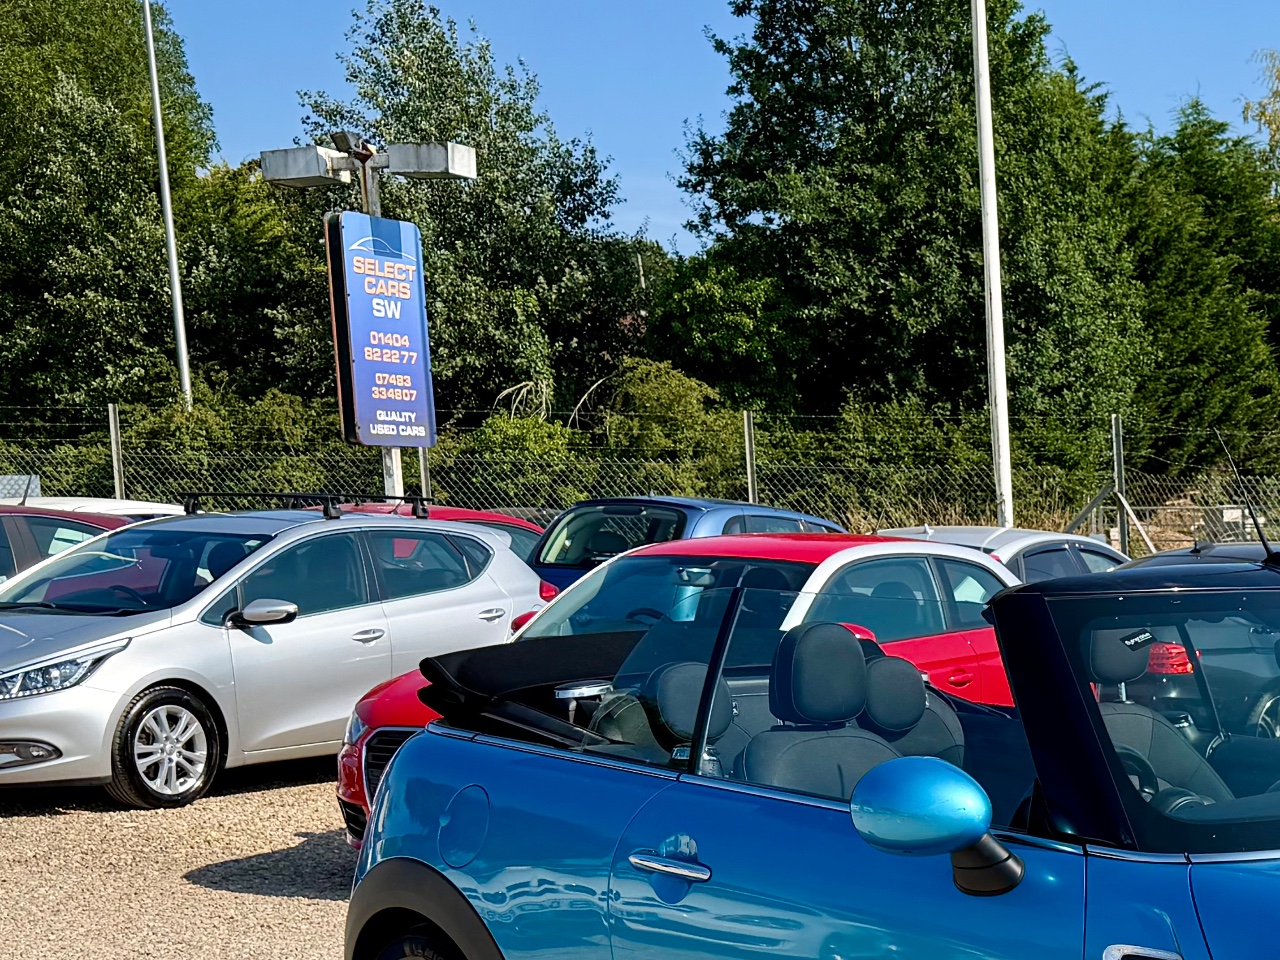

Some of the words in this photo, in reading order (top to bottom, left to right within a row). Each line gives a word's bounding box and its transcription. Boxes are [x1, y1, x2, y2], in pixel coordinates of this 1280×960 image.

[353, 256, 416, 282] SELECT
[364, 277, 411, 300] CARS
[372, 298, 402, 320] SW
[370, 331, 410, 348] 01404
[371, 386, 417, 402] 334807
[376, 410, 416, 423] QUALITY
[370, 423, 397, 435] USED
[398, 424, 426, 437] CARS
